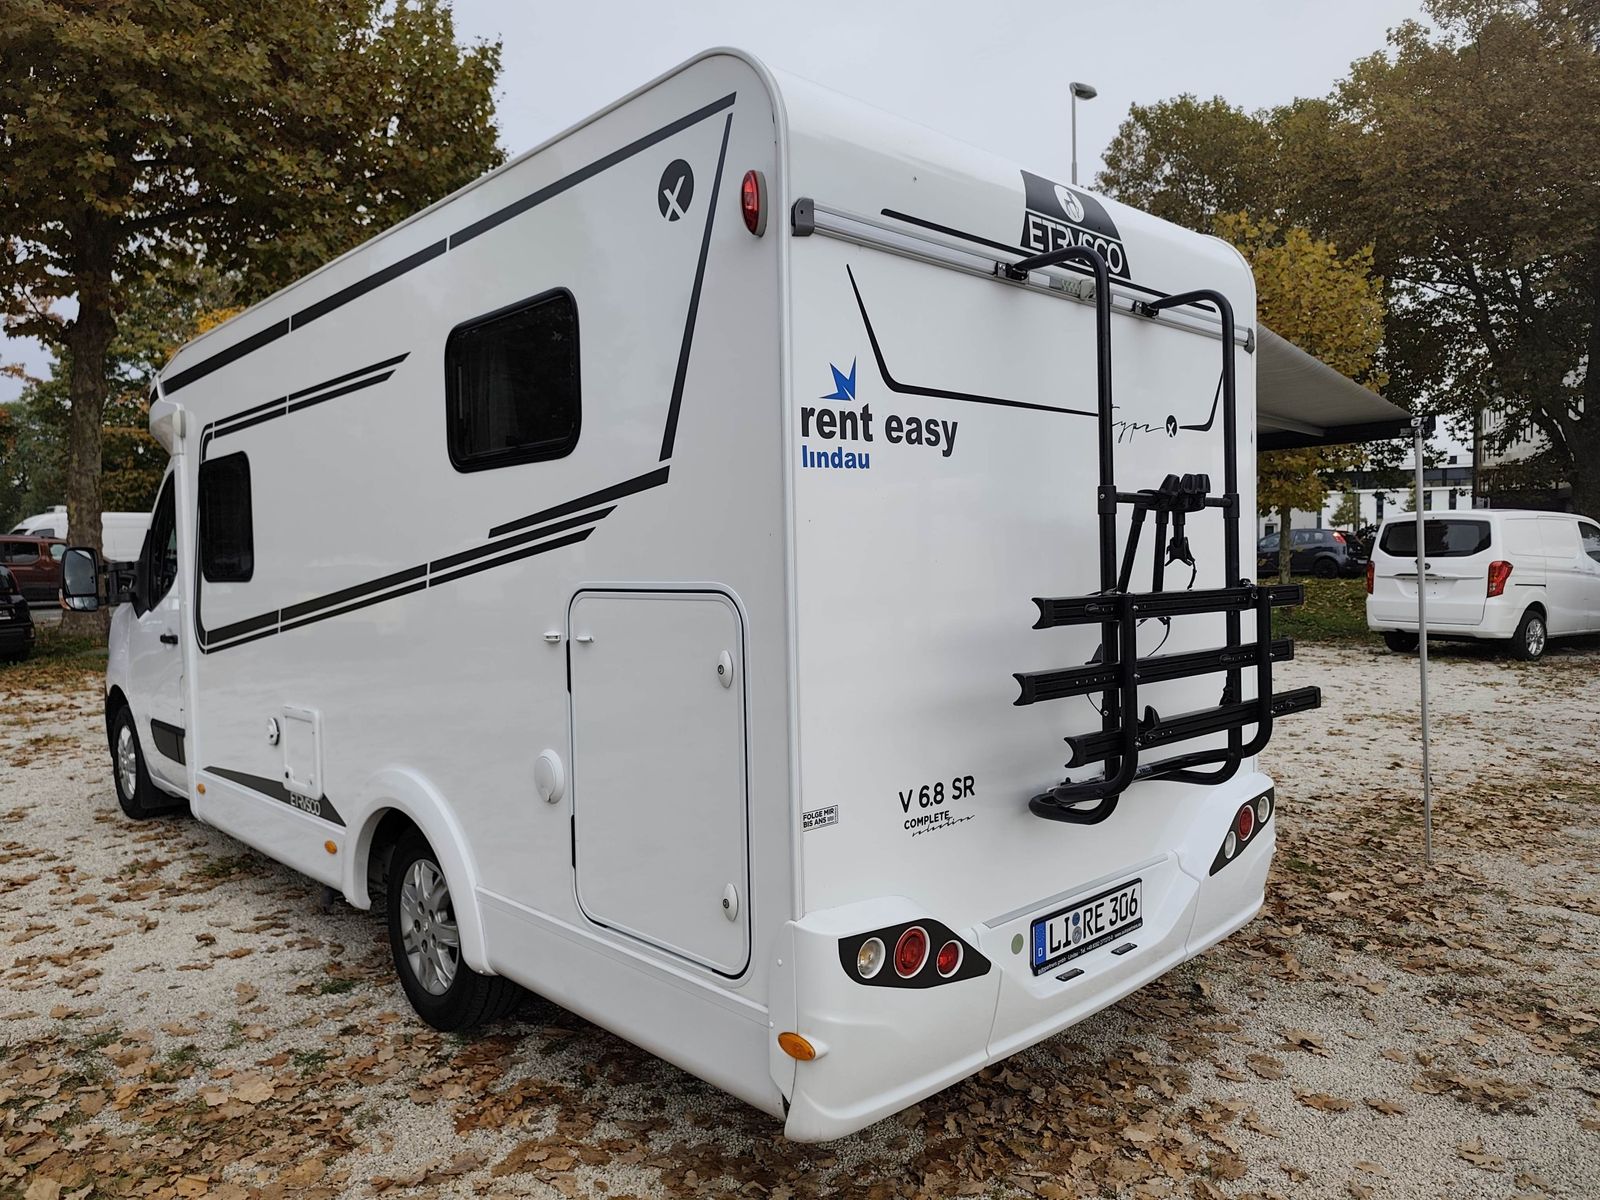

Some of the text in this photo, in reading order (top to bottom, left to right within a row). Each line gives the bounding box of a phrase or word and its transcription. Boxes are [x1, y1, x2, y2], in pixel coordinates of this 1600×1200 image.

[801, 403, 958, 458] rent easy
[899, 775, 975, 813] V 6.8 SR
[803, 810, 823, 821] FOLGE
[803, 819, 814, 828] BIS
[814, 816, 827, 825] ANS
[903, 810, 950, 829] COMPLETE
[1049, 916, 1072, 954] LI
[1083, 902, 1106, 939] RE
[1109, 888, 1138, 926] 306
[1038, 947, 1043, 957] D
